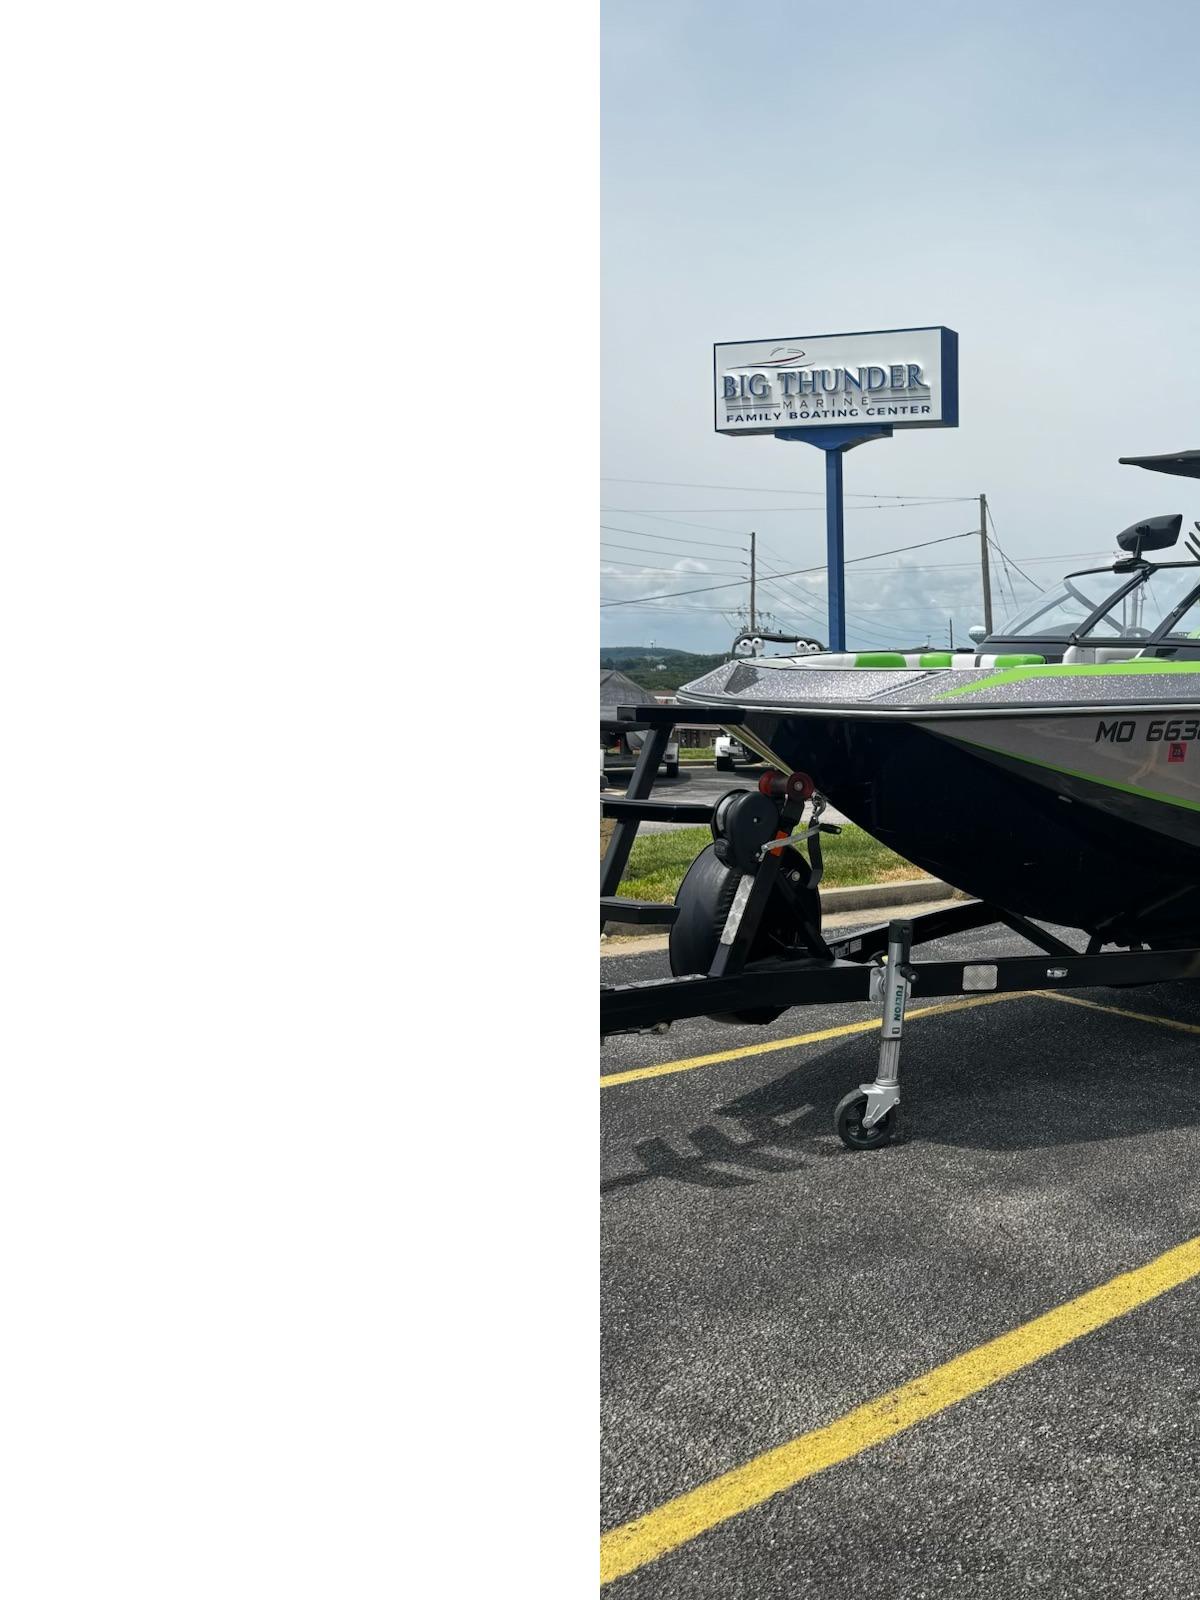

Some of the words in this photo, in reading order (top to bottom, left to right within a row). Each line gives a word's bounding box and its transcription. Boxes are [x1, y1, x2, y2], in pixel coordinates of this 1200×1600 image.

[722, 373, 771, 400] BIG
[777, 364, 929, 397] THUNDER
[727, 412, 781, 423] FAMILY
[789, 408, 858, 419] BOATING
[866, 405, 931, 416] CENTER
[783, 396, 869, 410] MARINE
[1095, 721, 1136, 743] MO
[894, 985, 904, 1021] FULTON
